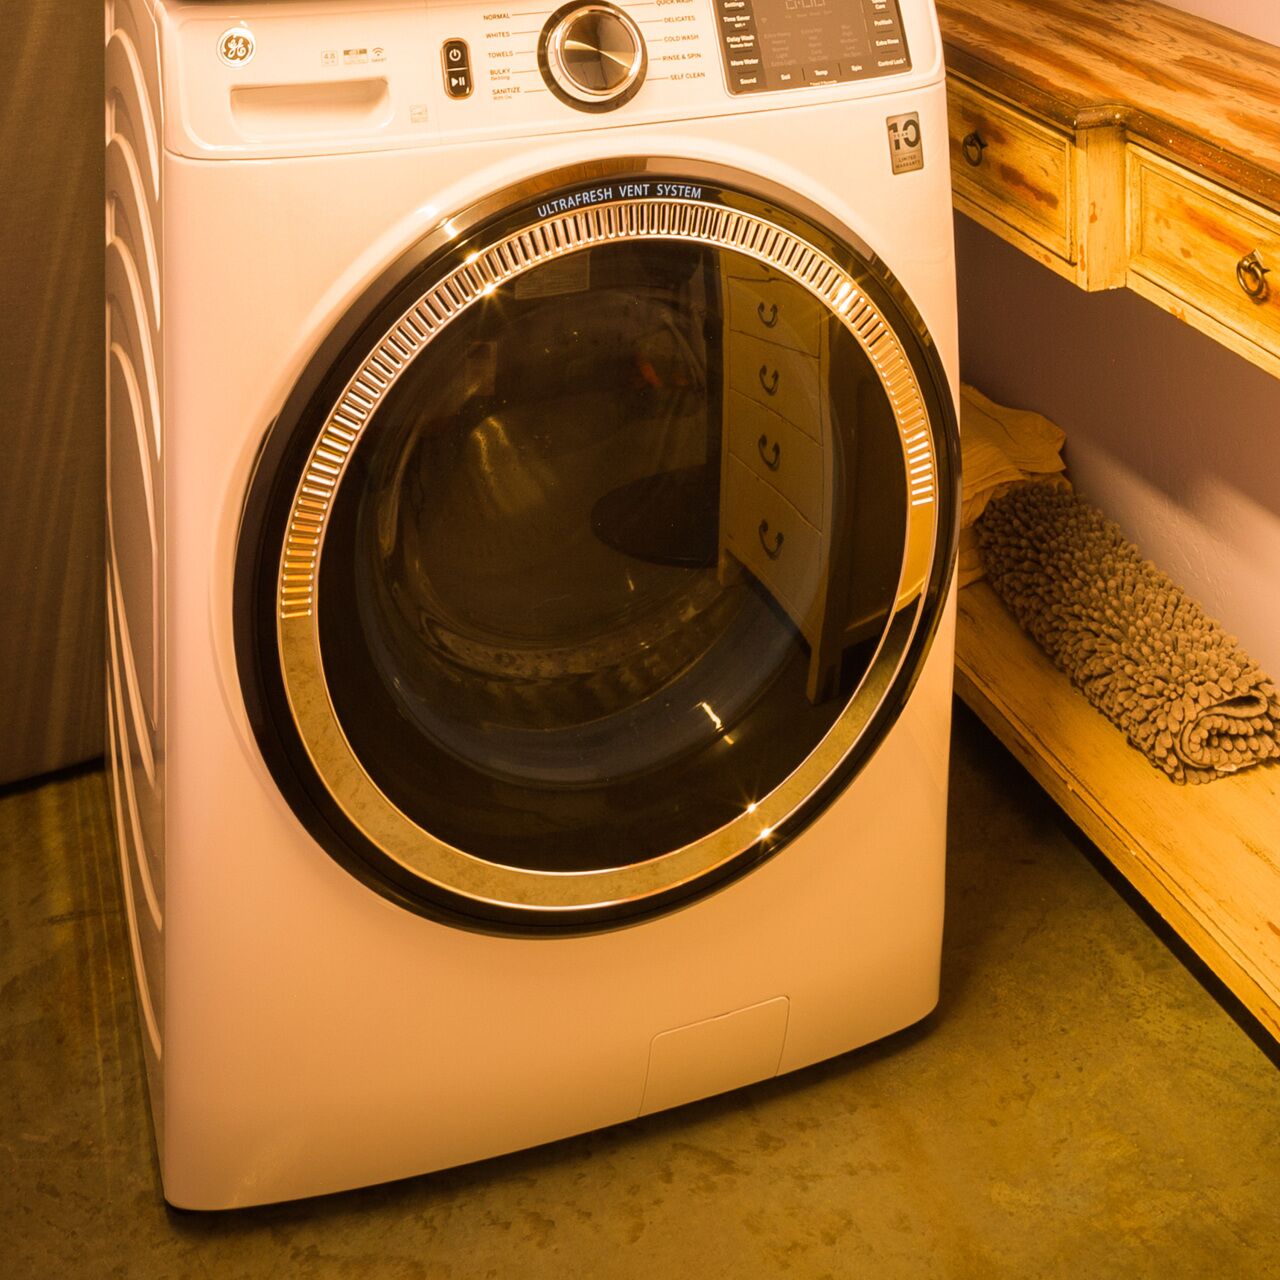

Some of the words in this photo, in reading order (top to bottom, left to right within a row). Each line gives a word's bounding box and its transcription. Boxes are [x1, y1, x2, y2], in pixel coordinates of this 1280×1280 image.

[483, 13, 510, 21] NORMAL
[663, 15, 696, 23] DELICATES
[485, 31, 511, 39] WHITES
[489, 68, 511, 76] BULKY
[670, 73, 684, 81] SELF
[684, 71, 706, 79] CLEAN
[491, 86, 521, 95] SANITIZE
[888, 119, 920, 150] 10
[898, 154, 916, 162] LIMITED
[896, 160, 920, 168] WARRANTY
[537, 187, 612, 217] ULTRAFRESH
[619, 184, 650, 197] VENT
[656, 184, 702, 199] SYSTEM
